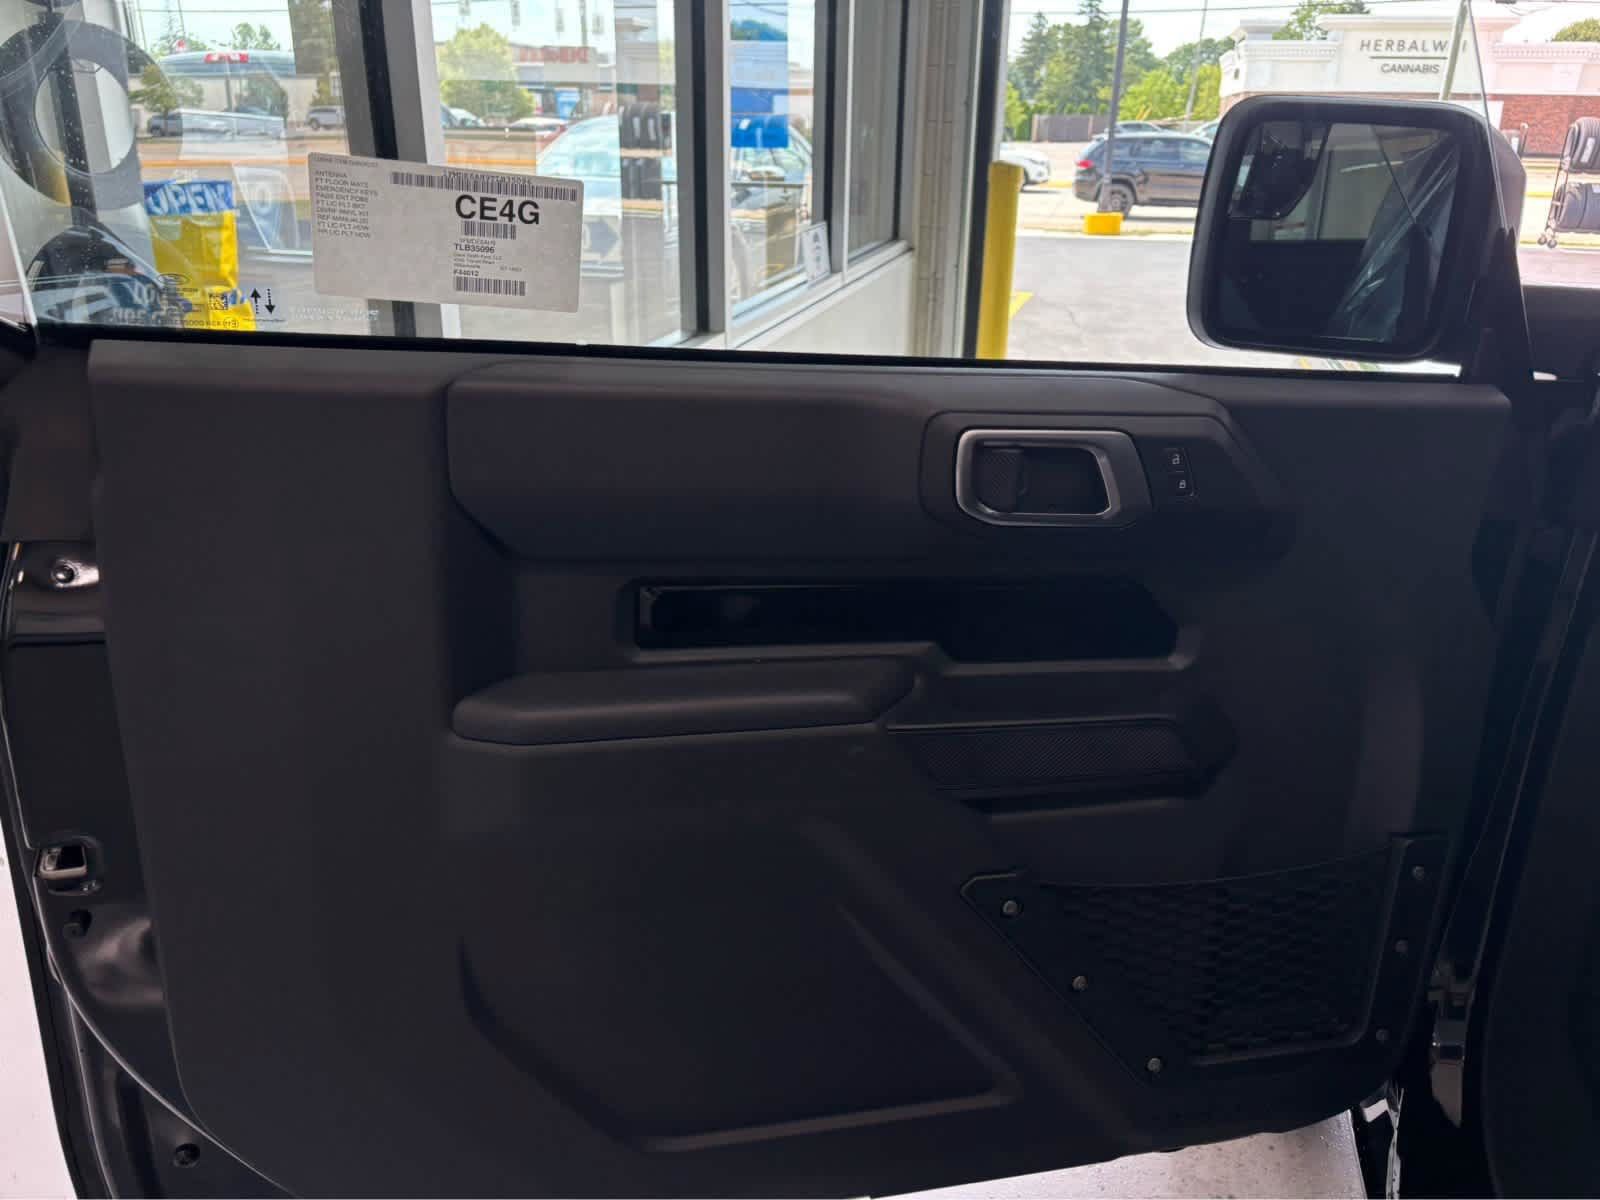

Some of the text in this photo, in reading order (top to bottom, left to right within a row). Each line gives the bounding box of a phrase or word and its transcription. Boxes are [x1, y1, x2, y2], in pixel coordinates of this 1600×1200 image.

[1380, 63, 1440, 74] CANNABIS
[455, 194, 540, 225] CE4G
[454, 243, 495, 253] TLB35096
